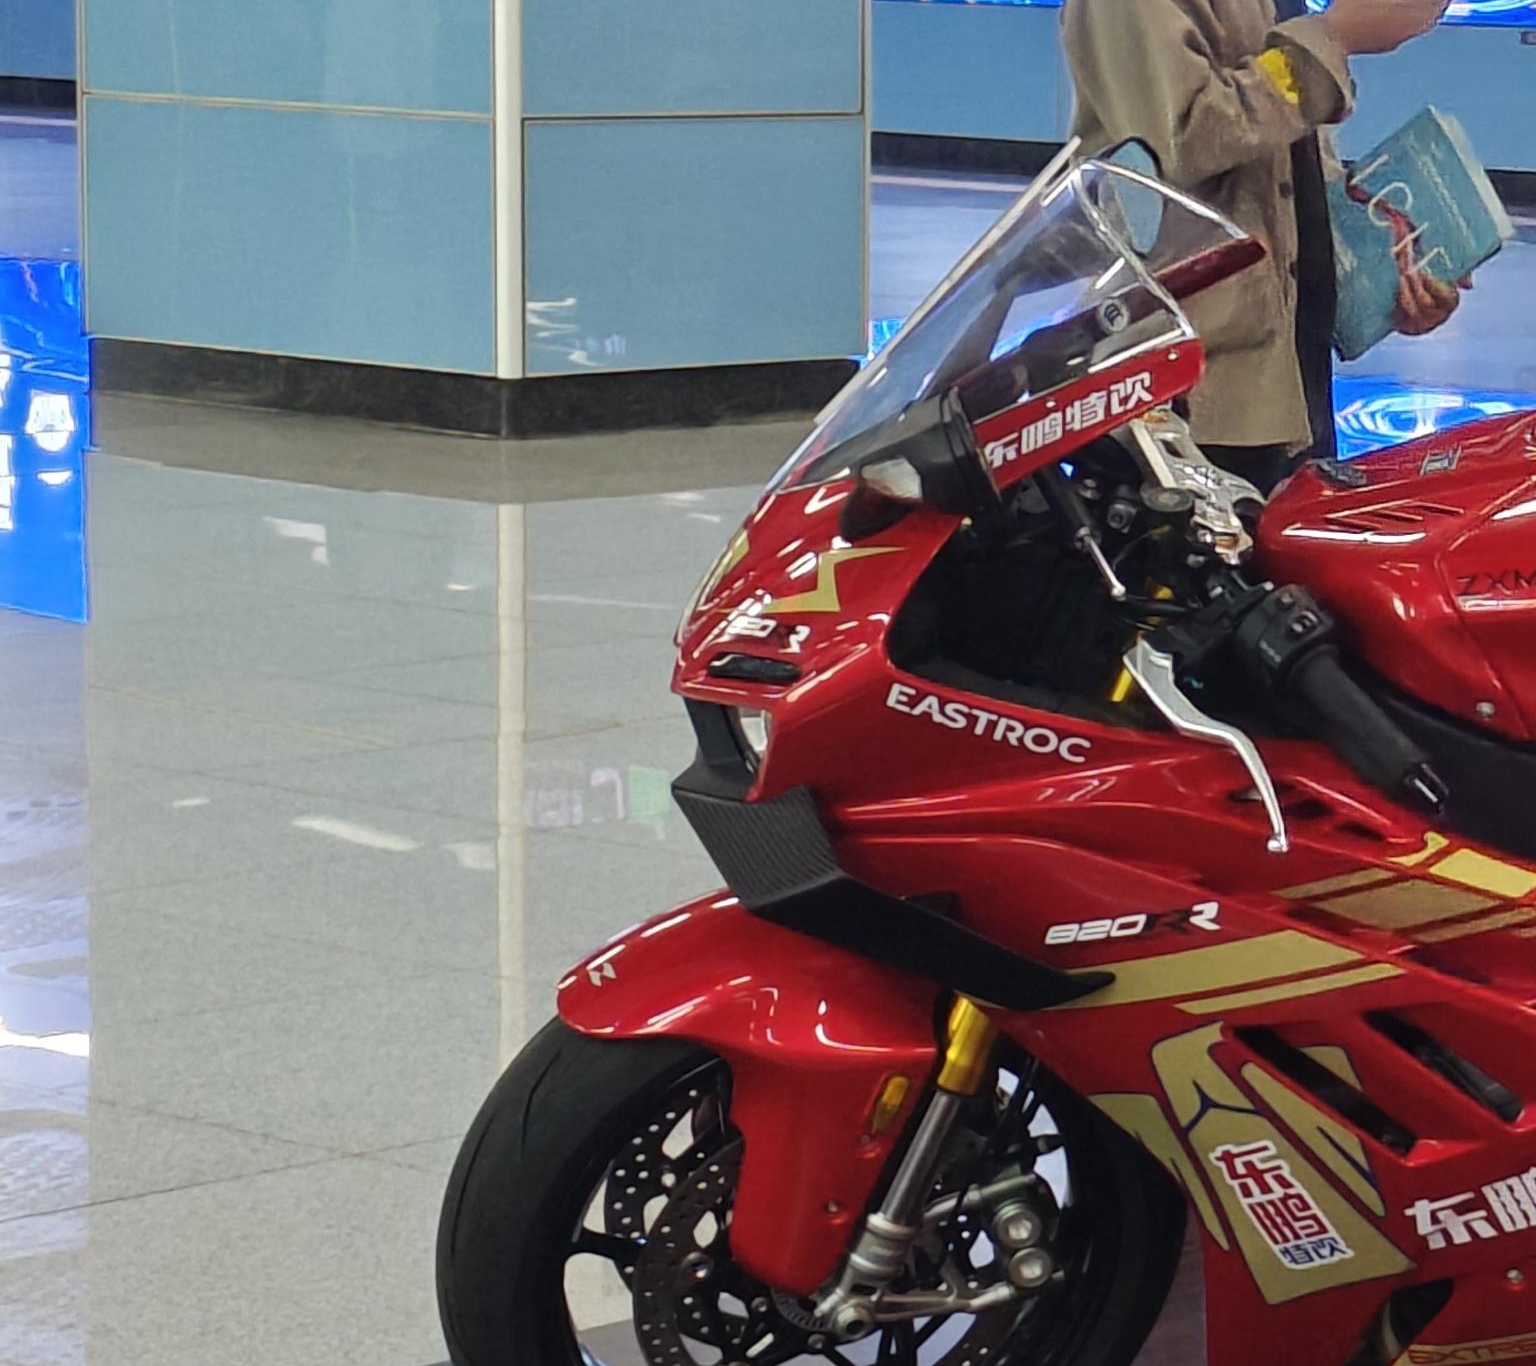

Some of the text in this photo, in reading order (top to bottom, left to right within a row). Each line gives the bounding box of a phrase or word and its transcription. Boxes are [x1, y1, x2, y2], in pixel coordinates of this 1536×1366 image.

[983, 371, 1153, 469] 东鹏特饮
[886, 682, 1092, 764] EASTROC
